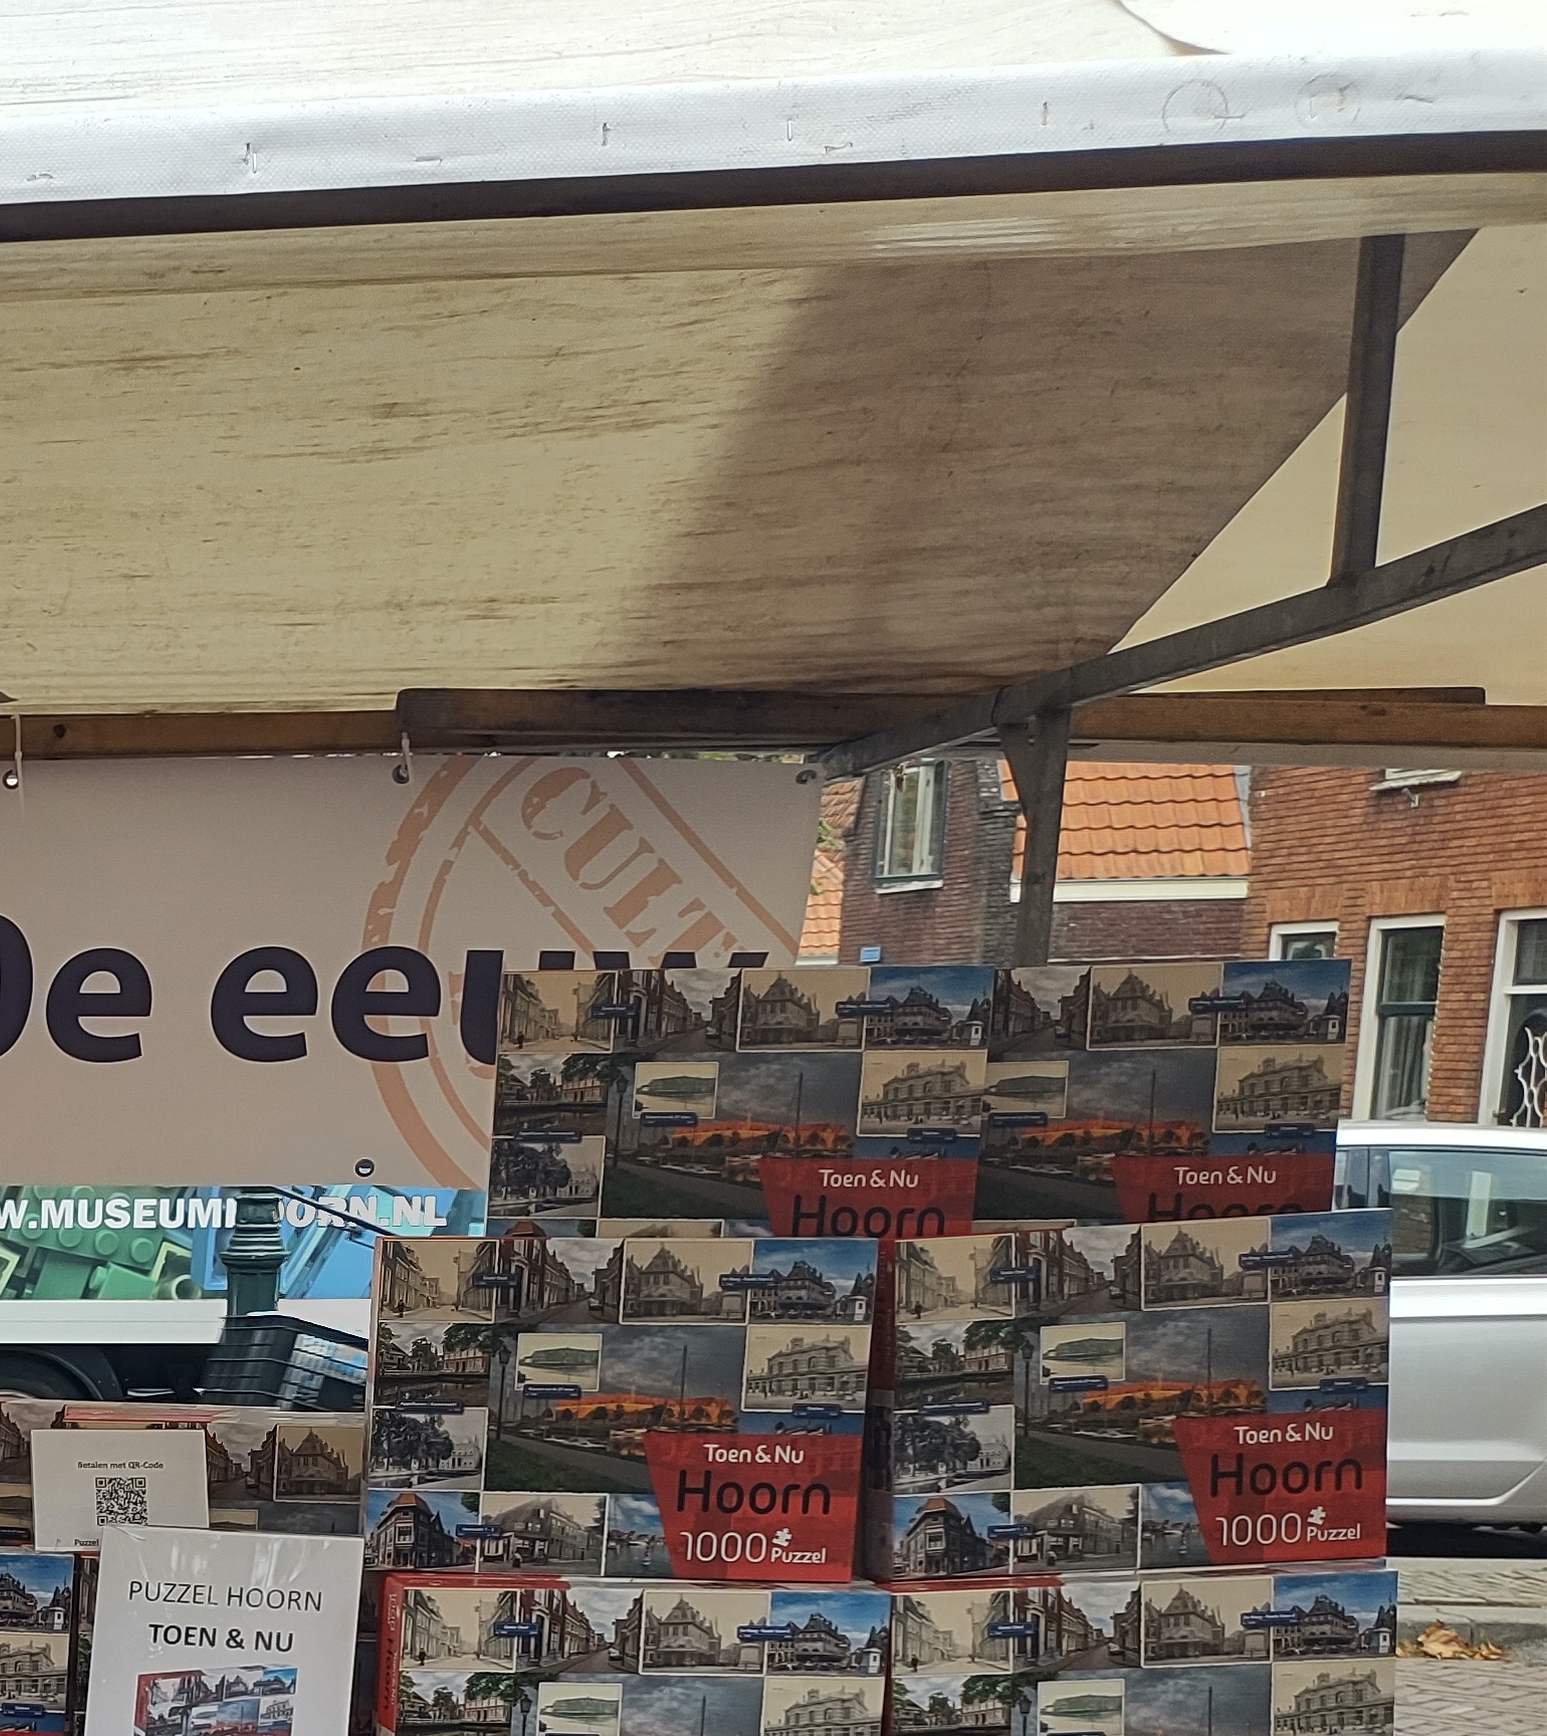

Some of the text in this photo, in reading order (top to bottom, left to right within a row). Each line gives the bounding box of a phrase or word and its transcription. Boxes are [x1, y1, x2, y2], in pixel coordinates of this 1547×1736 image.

[819, 1169, 919, 1188] Toen & Nu
[1174, 1165, 1276, 1185] Toen & Nu
[793, 1195, 945, 1237] Hoorn
[1233, 1422, 1333, 1445] Toen & Nu
[77, 1461, 164, 1470] Betalen met QR-Code
[704, 1444, 804, 1464] Toen & Nu
[1210, 1453, 1363, 1498] Hoorn
[677, 1469, 830, 1515] Hoorn
[1215, 1512, 1361, 1547] 1000 Puzzel
[679, 1531, 826, 1565] 1000 Puzzel
[129, 1581, 322, 1612] PUZZEL HOORN
[148, 1624, 294, 1652] TOEN & NU
